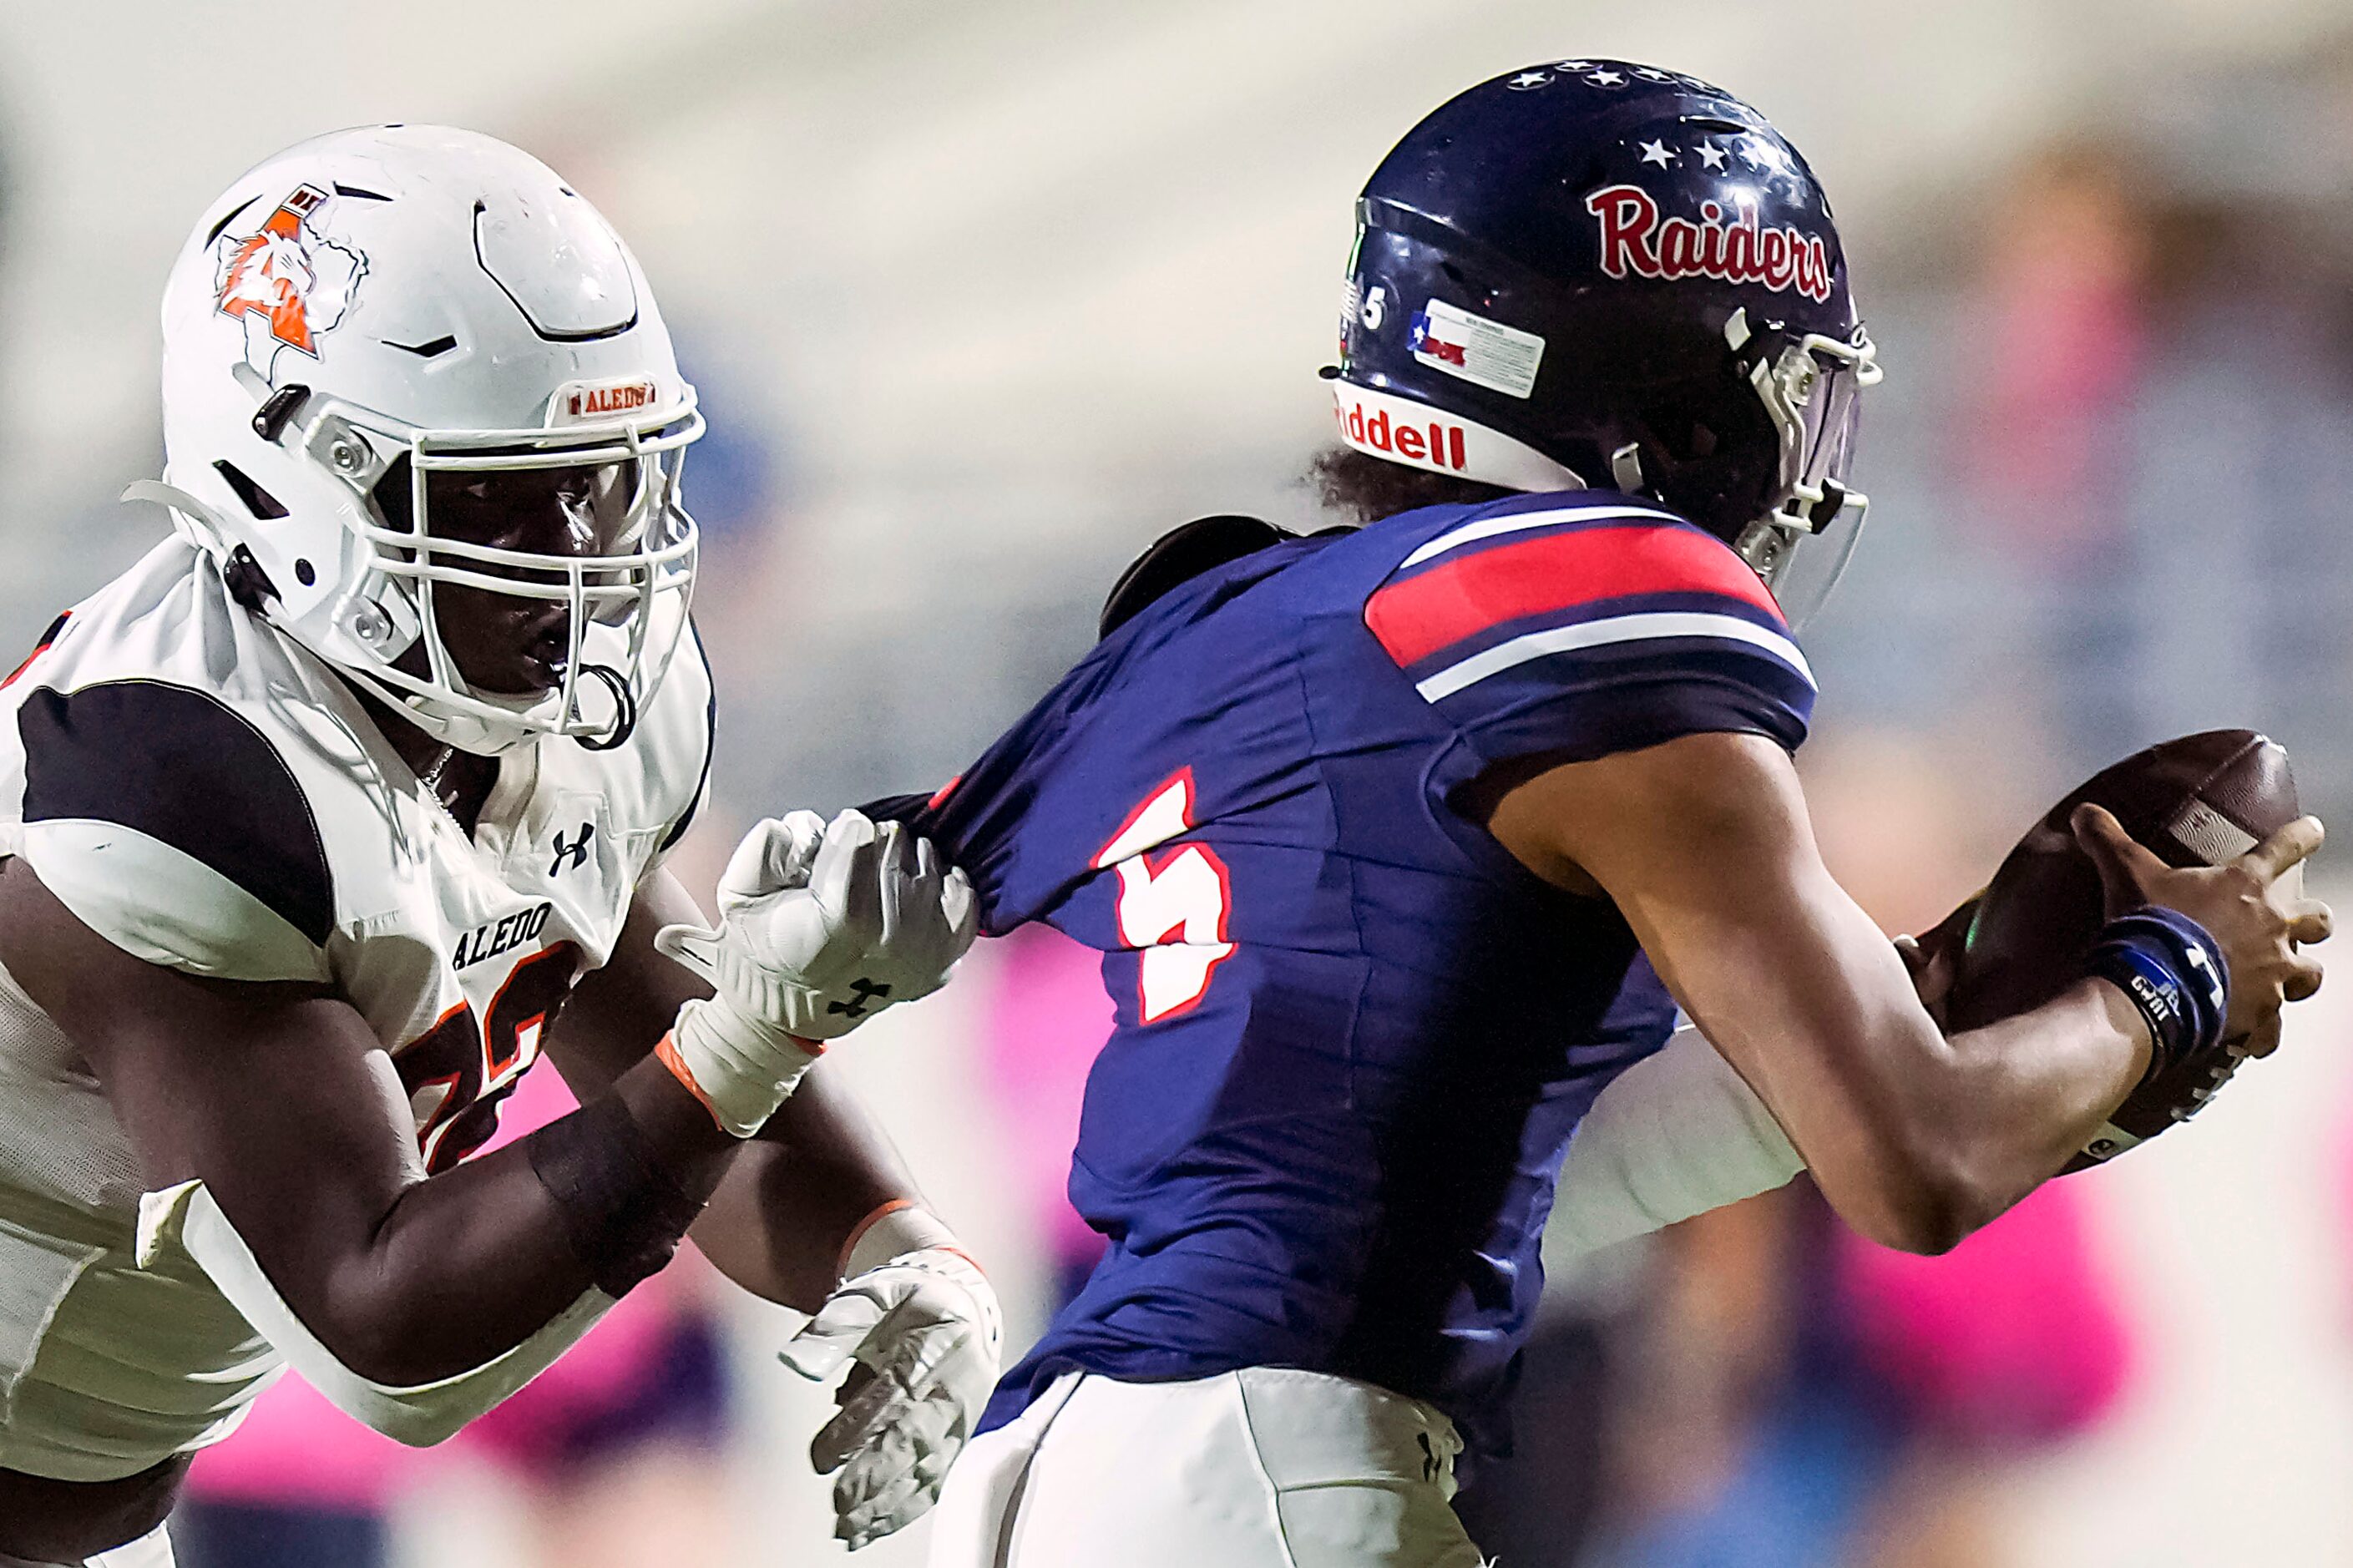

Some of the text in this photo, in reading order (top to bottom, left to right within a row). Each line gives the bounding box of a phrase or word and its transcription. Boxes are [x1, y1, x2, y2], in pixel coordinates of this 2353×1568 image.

[1586, 185, 1831, 304] Raiders
[1363, 286, 1386, 330] 5
[585, 387, 645, 412] ALEDO
[452, 902, 553, 971] ALEDO
